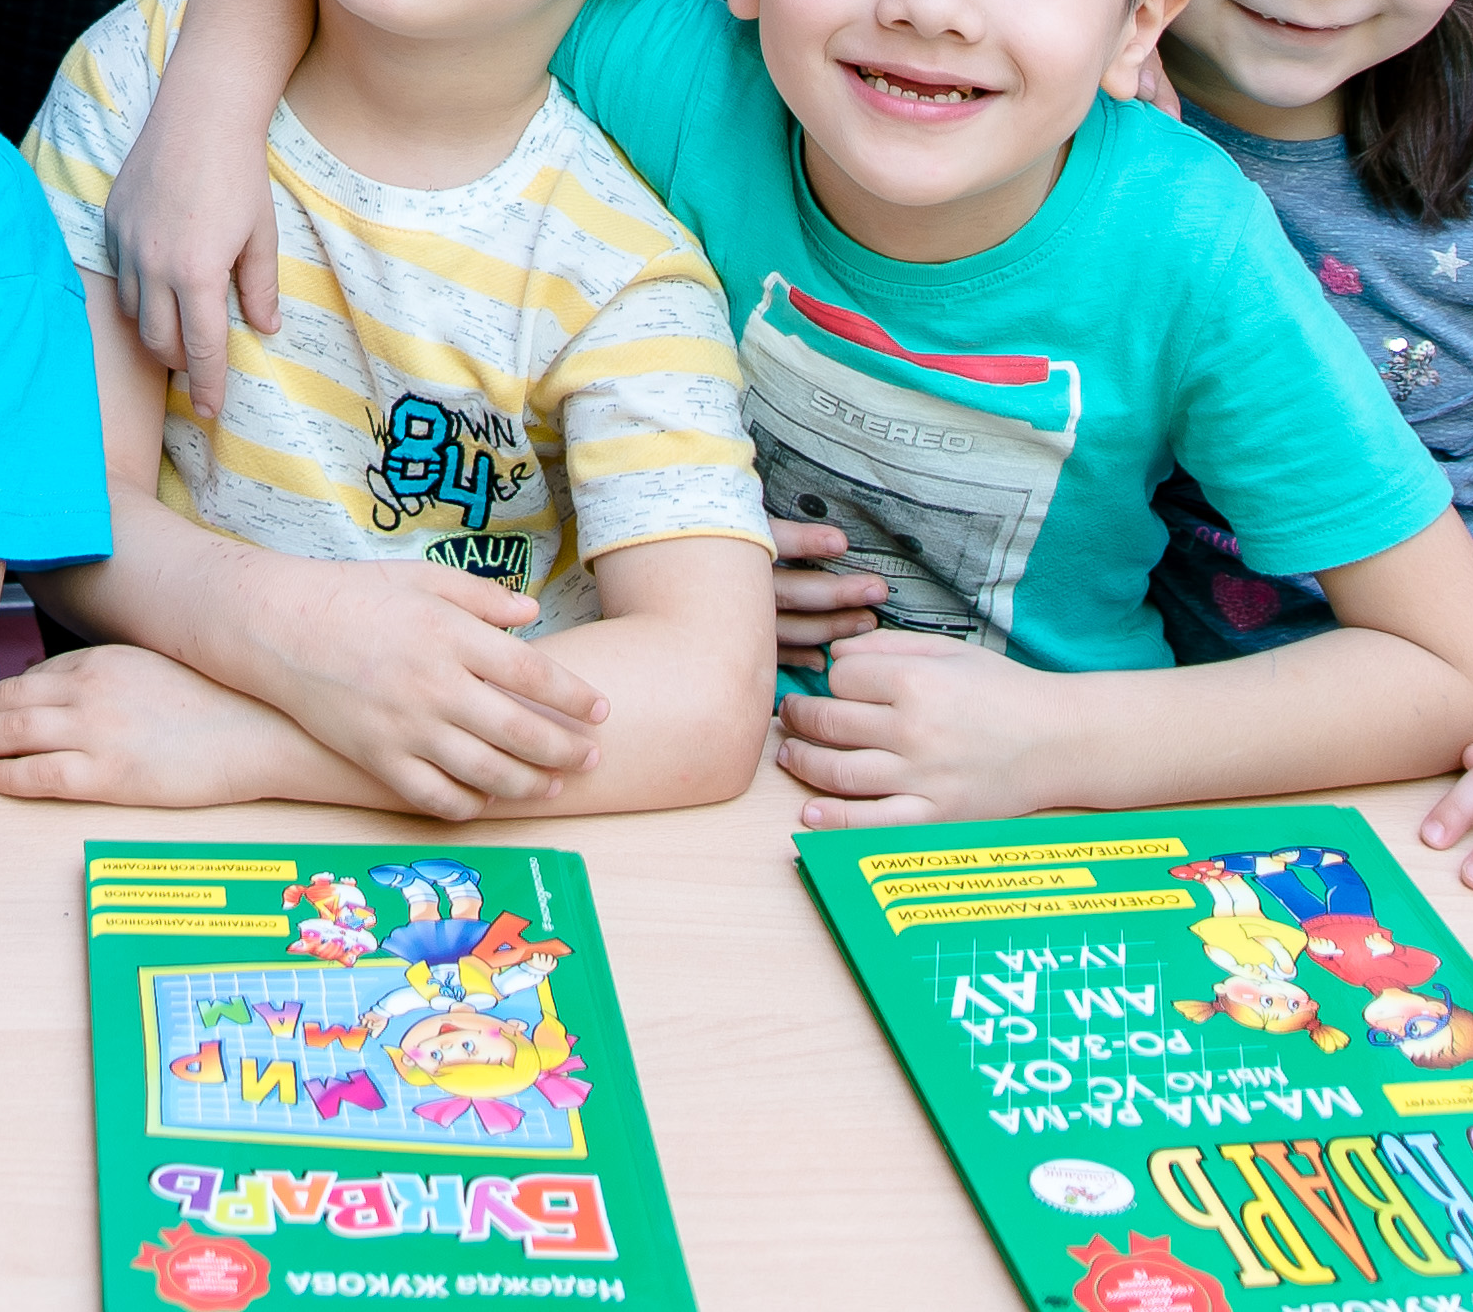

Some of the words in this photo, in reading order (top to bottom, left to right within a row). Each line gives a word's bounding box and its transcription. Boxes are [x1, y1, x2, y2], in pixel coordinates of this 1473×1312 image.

[809, 389, 974, 454] STEREO
[382, 391, 495, 530] 84
[870, 852, 978, 874] МЕТОДИКИ
[988, 839, 1172, 864] ЛОГОПЕДИЧЕСКОЙ
[101, 861, 167, 872] МЕТОДИКИ
[170, 863, 281, 873] ЛОГОПЕДИЧЕСКОЙ
[1050, 874, 1065, 886] И
[104, 890, 201, 901] ОРИГИНАЛЬНОЙ
[204, 891, 211, 900] И
[883, 875, 1046, 896] ОРИГИНАЛЬНОЙ
[897, 900, 1062, 923] ТРАДИЦИОННОЙ
[1065, 892, 1180, 912] СОЧЕТАНИЕ
[105, 918, 204, 929] ТРАДИЦИОННОЙ
[209, 919, 277, 929] СОЧЕТАНИЕ
[994, 943, 1127, 975] ЛУ-НА
[951, 970, 1039, 1020] АУ
[1065, 983, 1158, 1020] АМ
[198, 995, 368, 1051] МАМ
[961, 1016, 1039, 1048] СА
[1049, 1028, 1192, 1058] РО-ЗА
[170, 1040, 386, 1119] МИР
[977, 1060, 1070, 1098] ОХ
[1087, 1074, 1154, 1101] УС
[1165, 1066, 1288, 1093] МЫ-ЛО
[988, 1101, 1141, 1136] РА-МА
[1155, 1085, 1362, 1126] МА-МА
[286, 1270, 448, 1298] ЖУКОВА
[455, 1273, 625, 1302] Надежда
